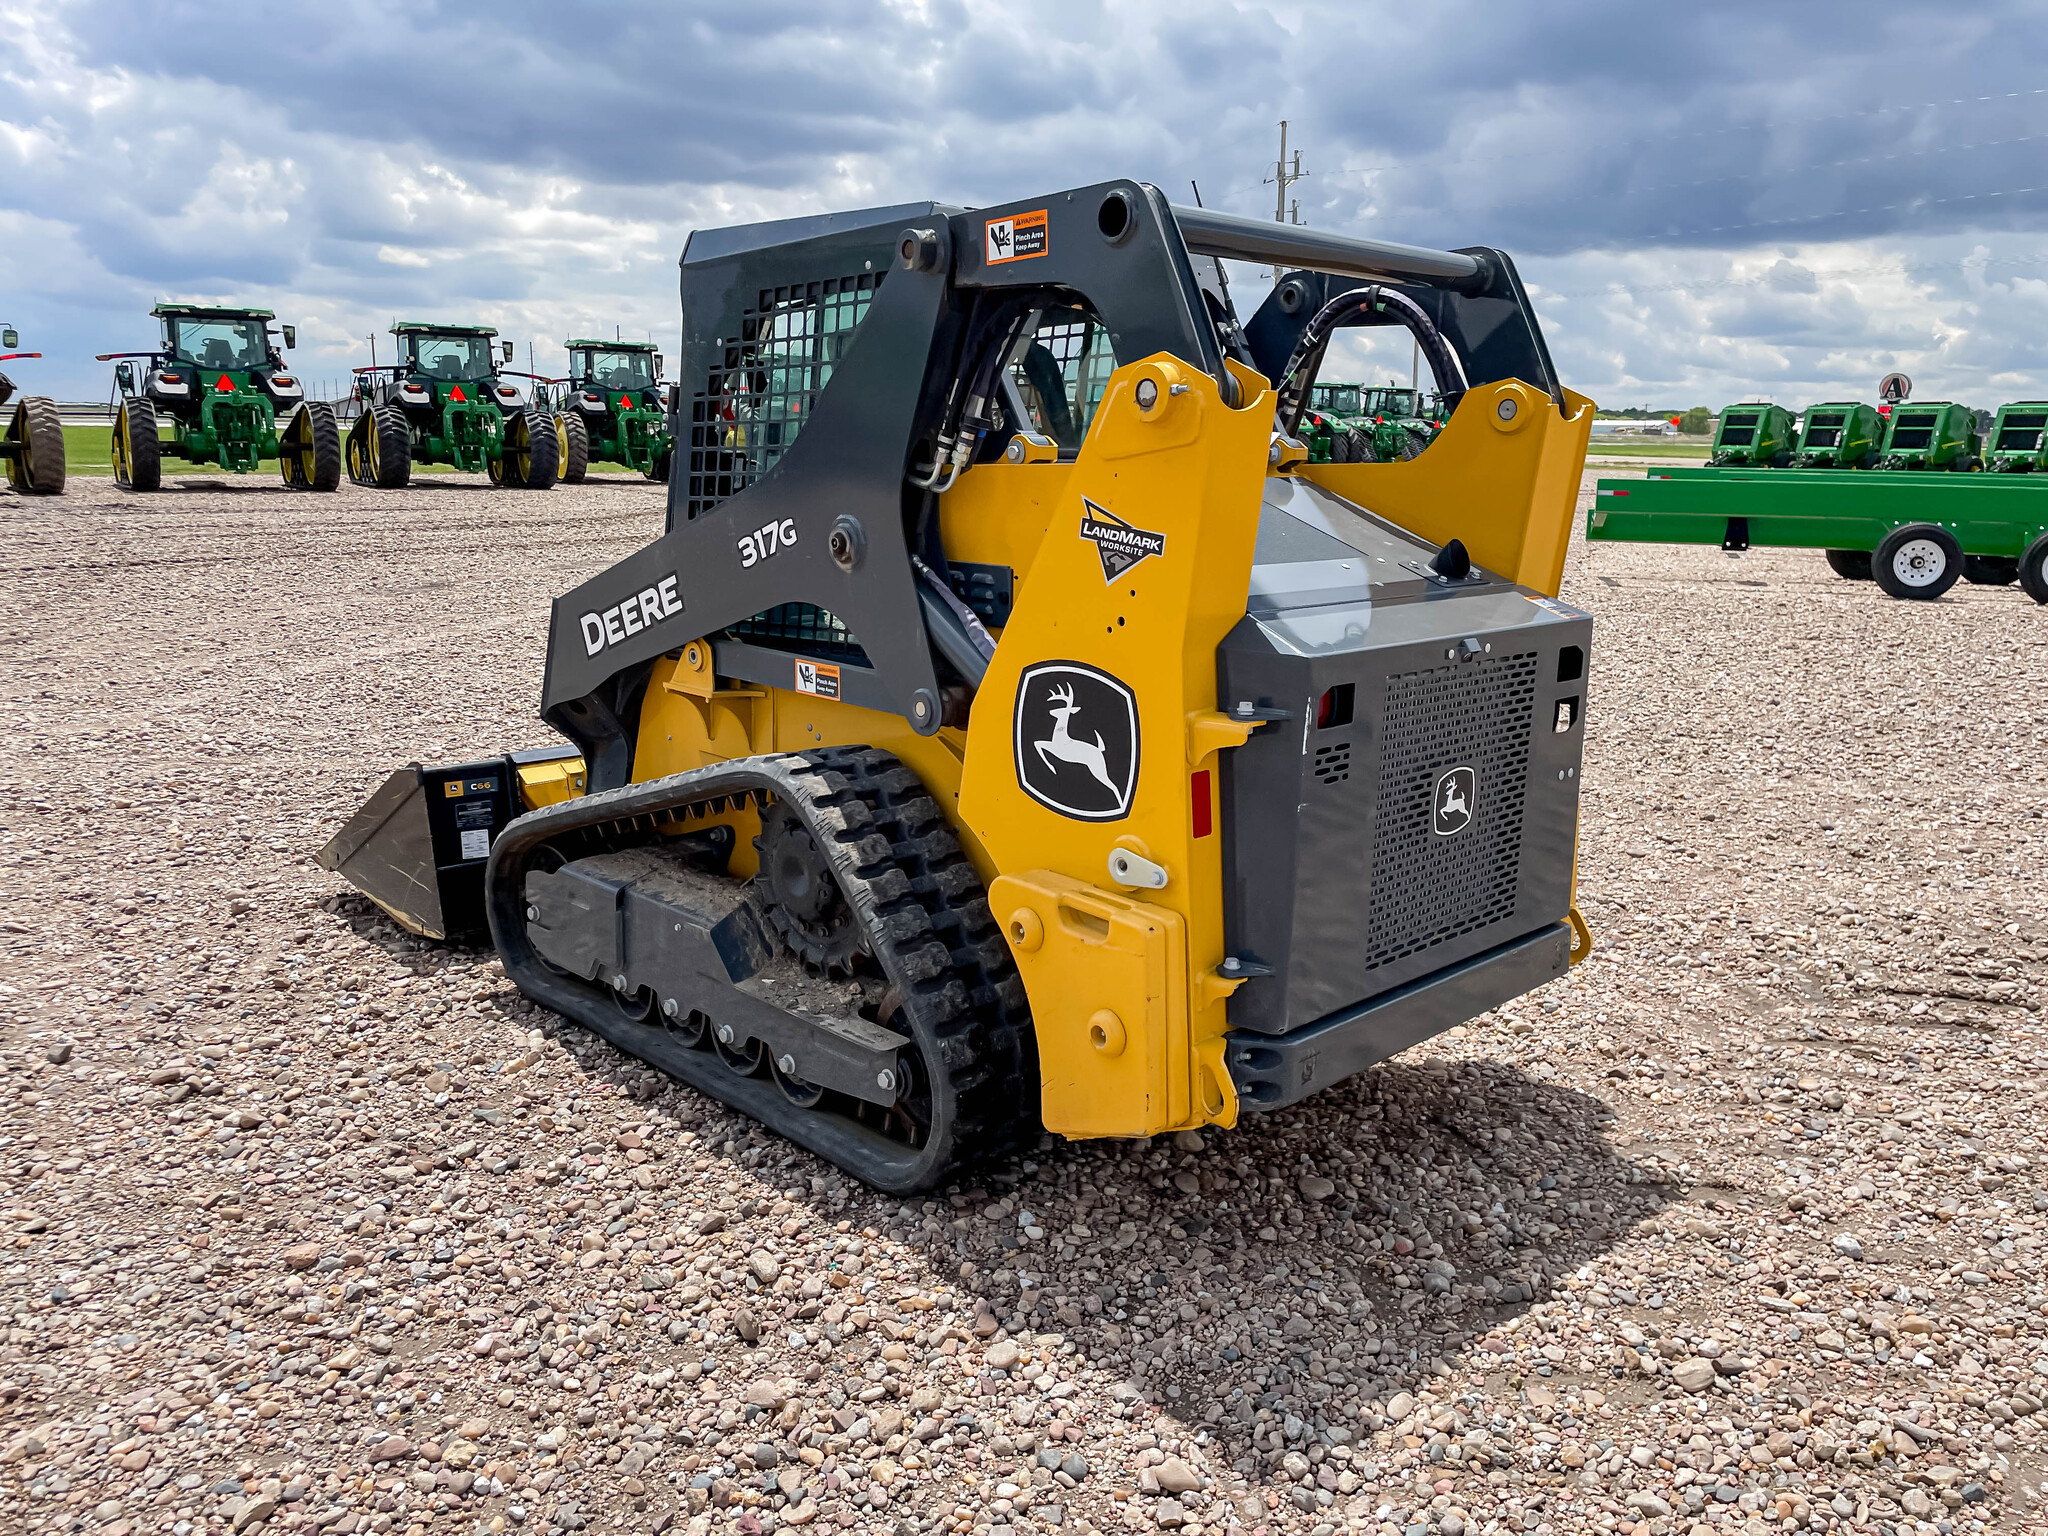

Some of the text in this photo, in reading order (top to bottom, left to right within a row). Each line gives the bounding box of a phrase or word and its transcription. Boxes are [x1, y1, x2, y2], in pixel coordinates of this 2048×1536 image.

[1019, 215, 1044, 225] WARNING
[1015, 231, 1044, 242] Pinch Area
[1884, 377, 1904, 398] A
[737, 518, 798, 568] 317G
[1100, 540, 1144, 557] WORKSITE
[580, 574, 683, 656] DEERE
[470, 781, 491, 791] C66
